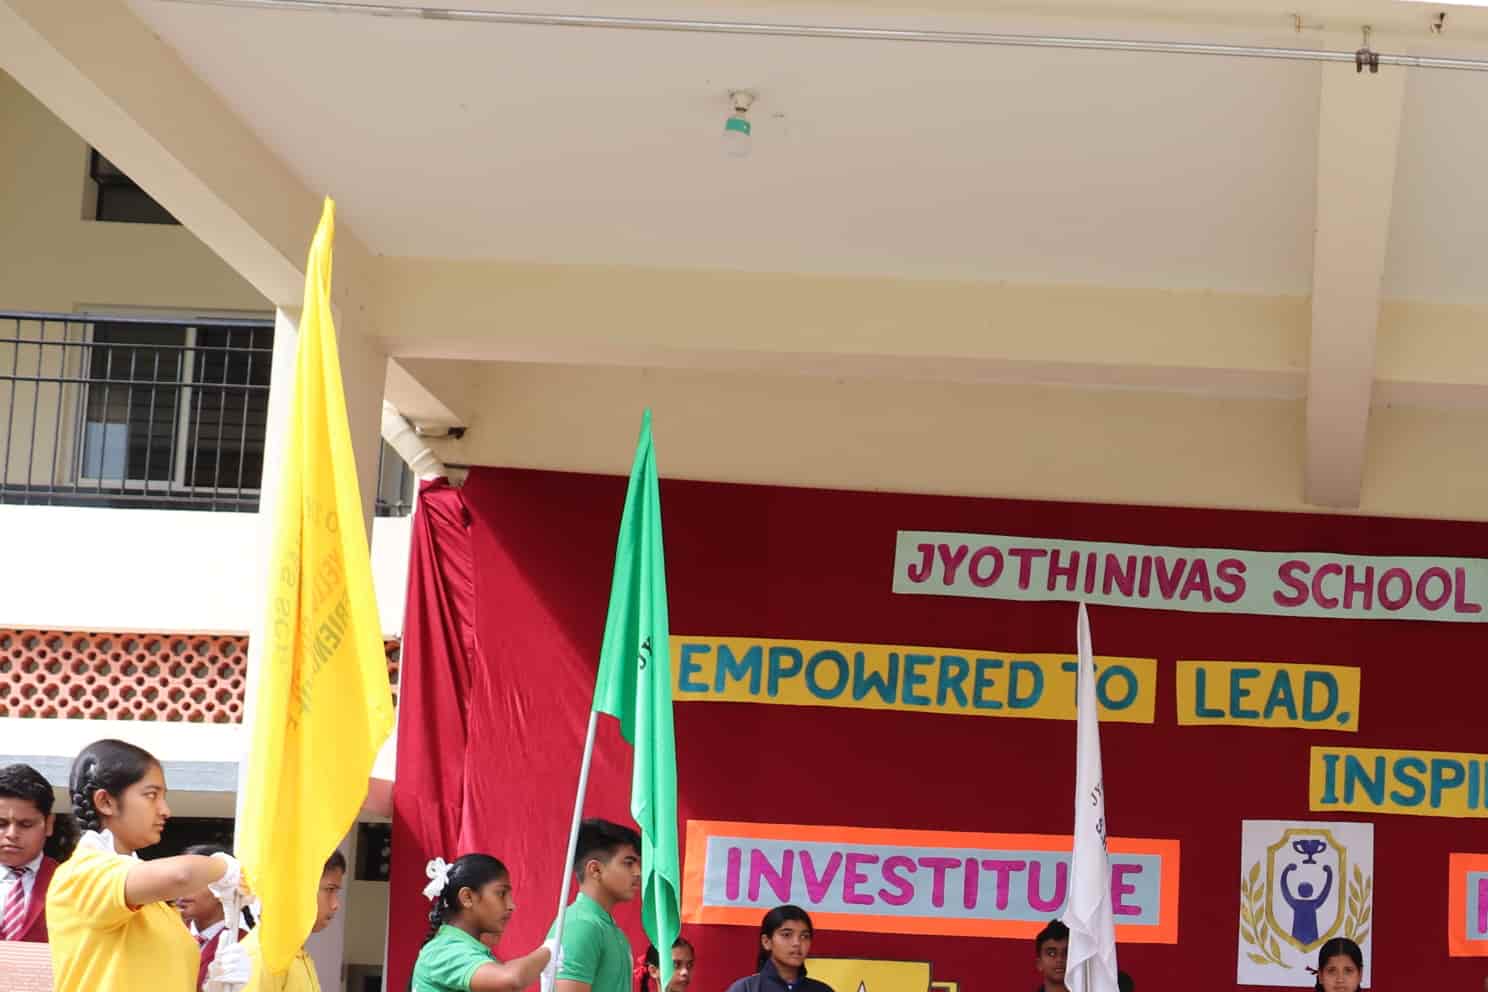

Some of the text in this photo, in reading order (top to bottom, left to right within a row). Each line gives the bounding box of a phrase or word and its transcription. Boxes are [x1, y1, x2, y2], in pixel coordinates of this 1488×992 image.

[906, 543, 1247, 603] JYOTHINIVAS
[1272, 560, 1482, 614] SCHOOL
[678, 643, 1045, 710] EMPOWERED
[726, 846, 1144, 916] INVESTITUE
